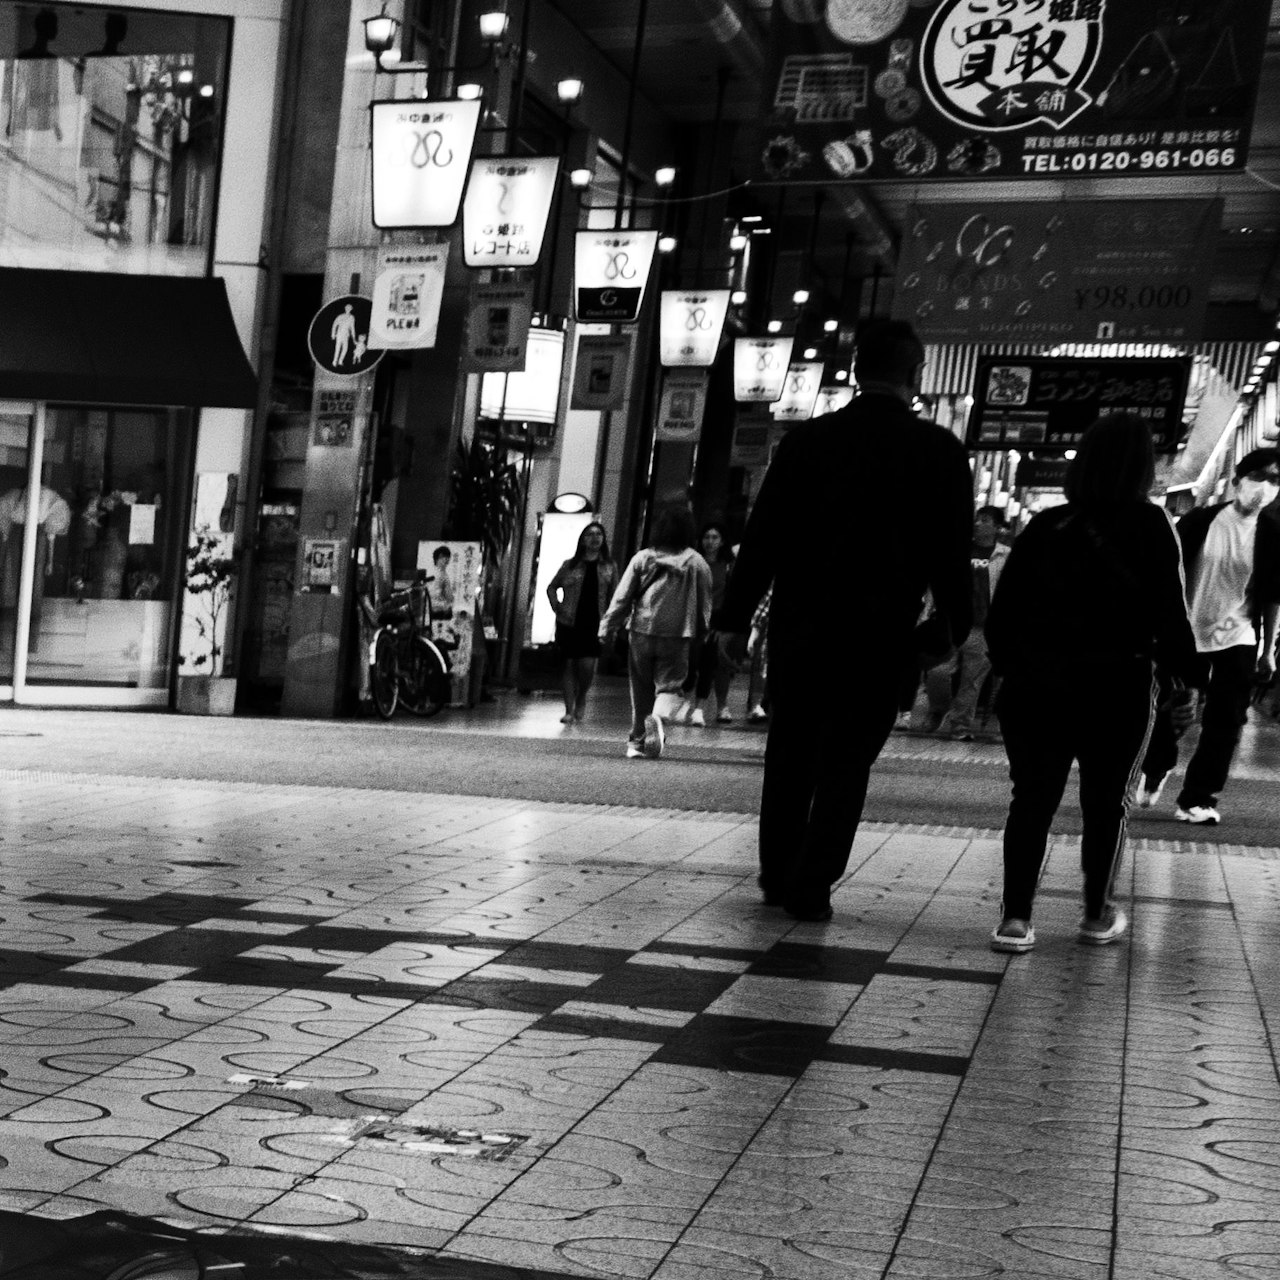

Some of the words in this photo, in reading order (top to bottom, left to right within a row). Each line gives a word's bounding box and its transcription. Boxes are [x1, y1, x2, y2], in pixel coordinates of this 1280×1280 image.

[942, 18, 1070, 91] 買取
[996, 88, 1068, 115] 本舗
[1022, 148, 1236, 172] TEL:0120-961-066
